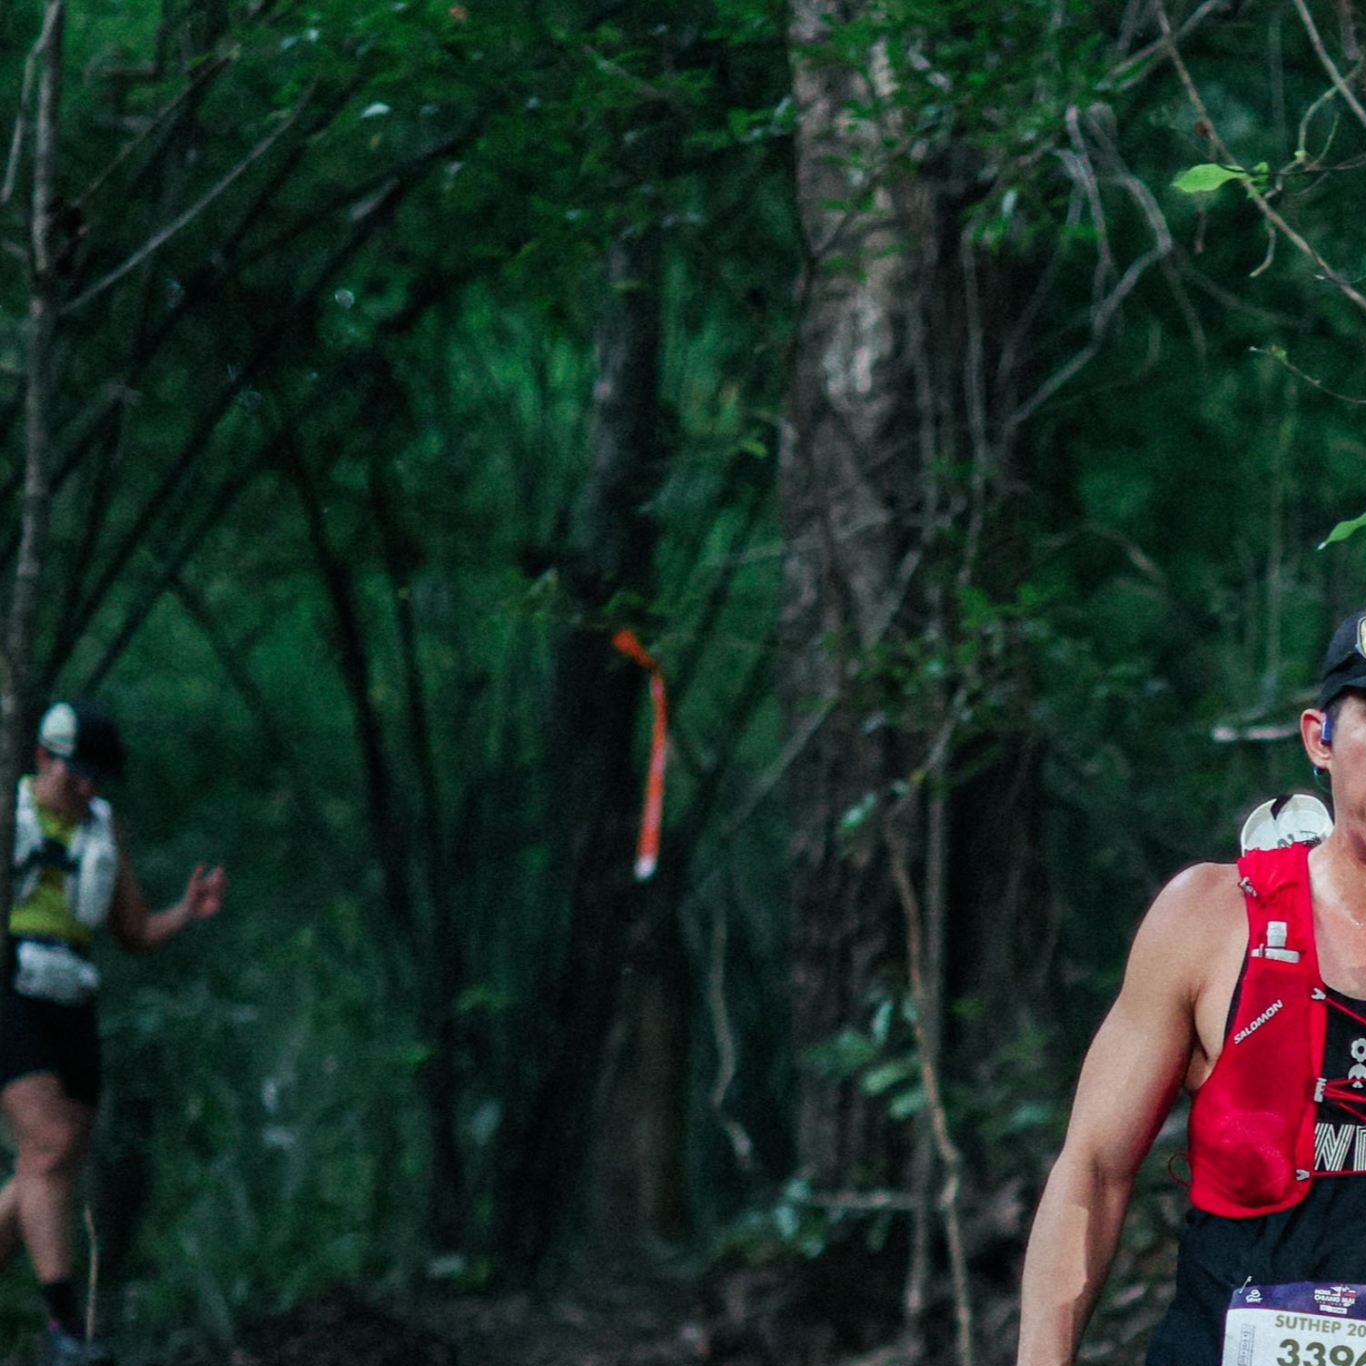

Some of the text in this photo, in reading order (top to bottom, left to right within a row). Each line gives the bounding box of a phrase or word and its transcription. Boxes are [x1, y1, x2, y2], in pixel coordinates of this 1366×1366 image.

[1234, 999, 1283, 1044] SALOMON
[1275, 1315, 1366, 1338] SUTHEP 20
